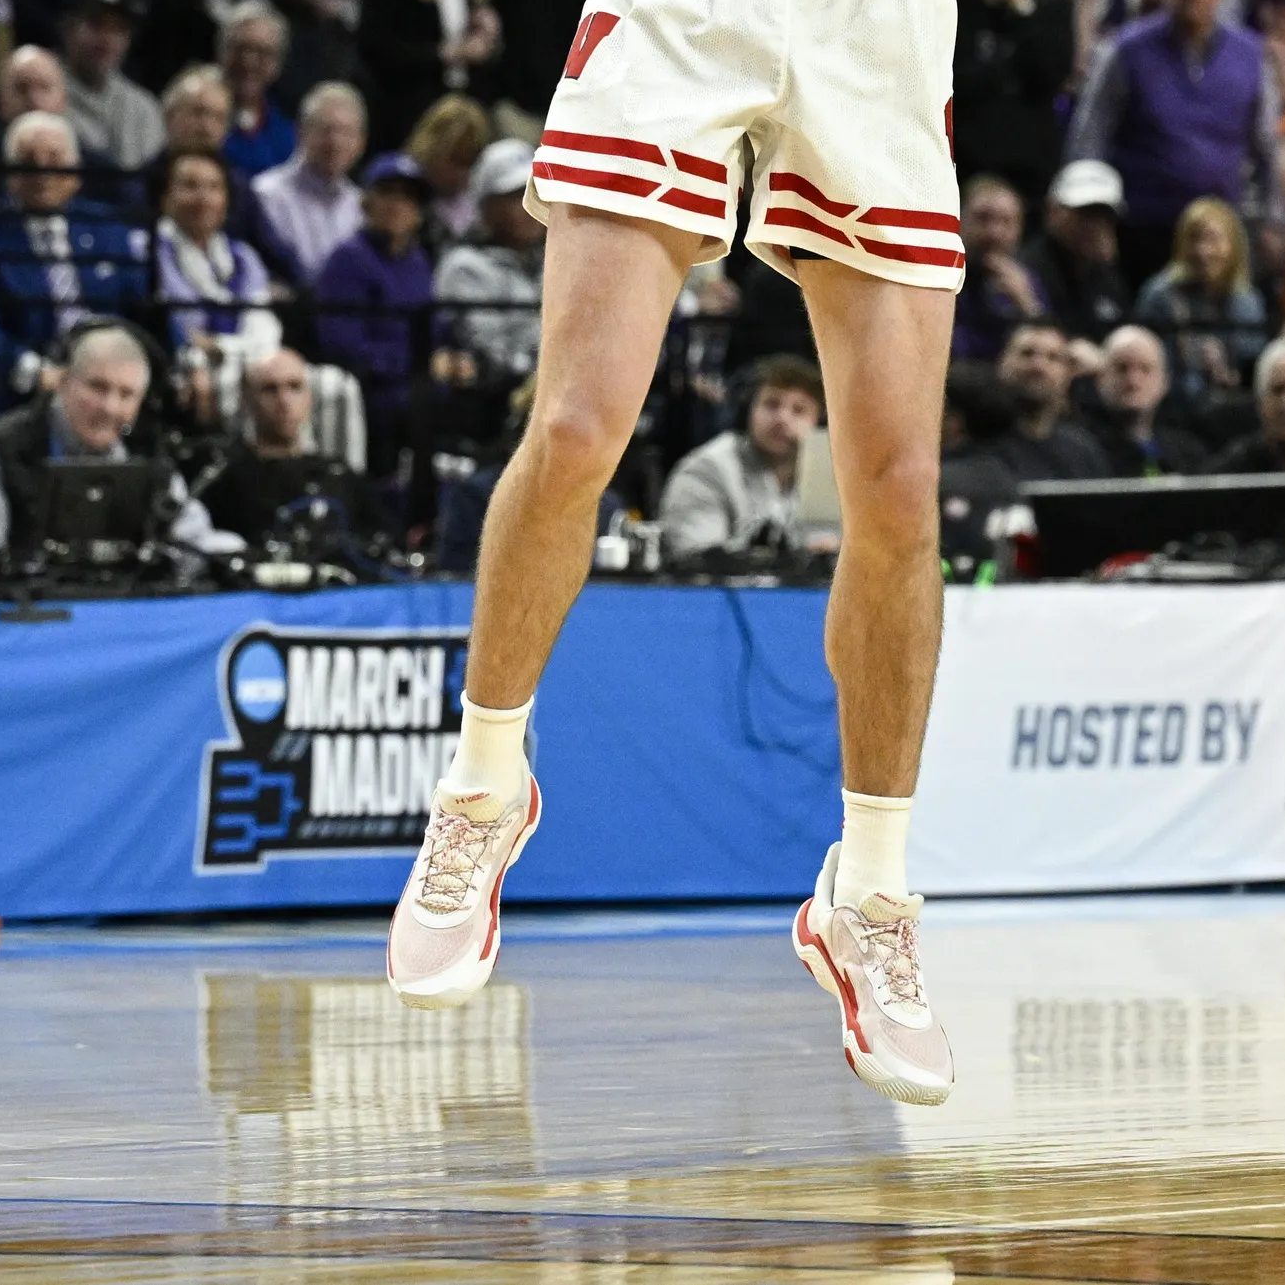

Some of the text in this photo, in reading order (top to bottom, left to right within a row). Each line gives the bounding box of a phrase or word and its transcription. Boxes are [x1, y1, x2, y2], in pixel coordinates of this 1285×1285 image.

[284, 645, 446, 729] MARCH
[308, 731, 463, 817] MADN
[1012, 697, 1261, 770] HOSTED BY
